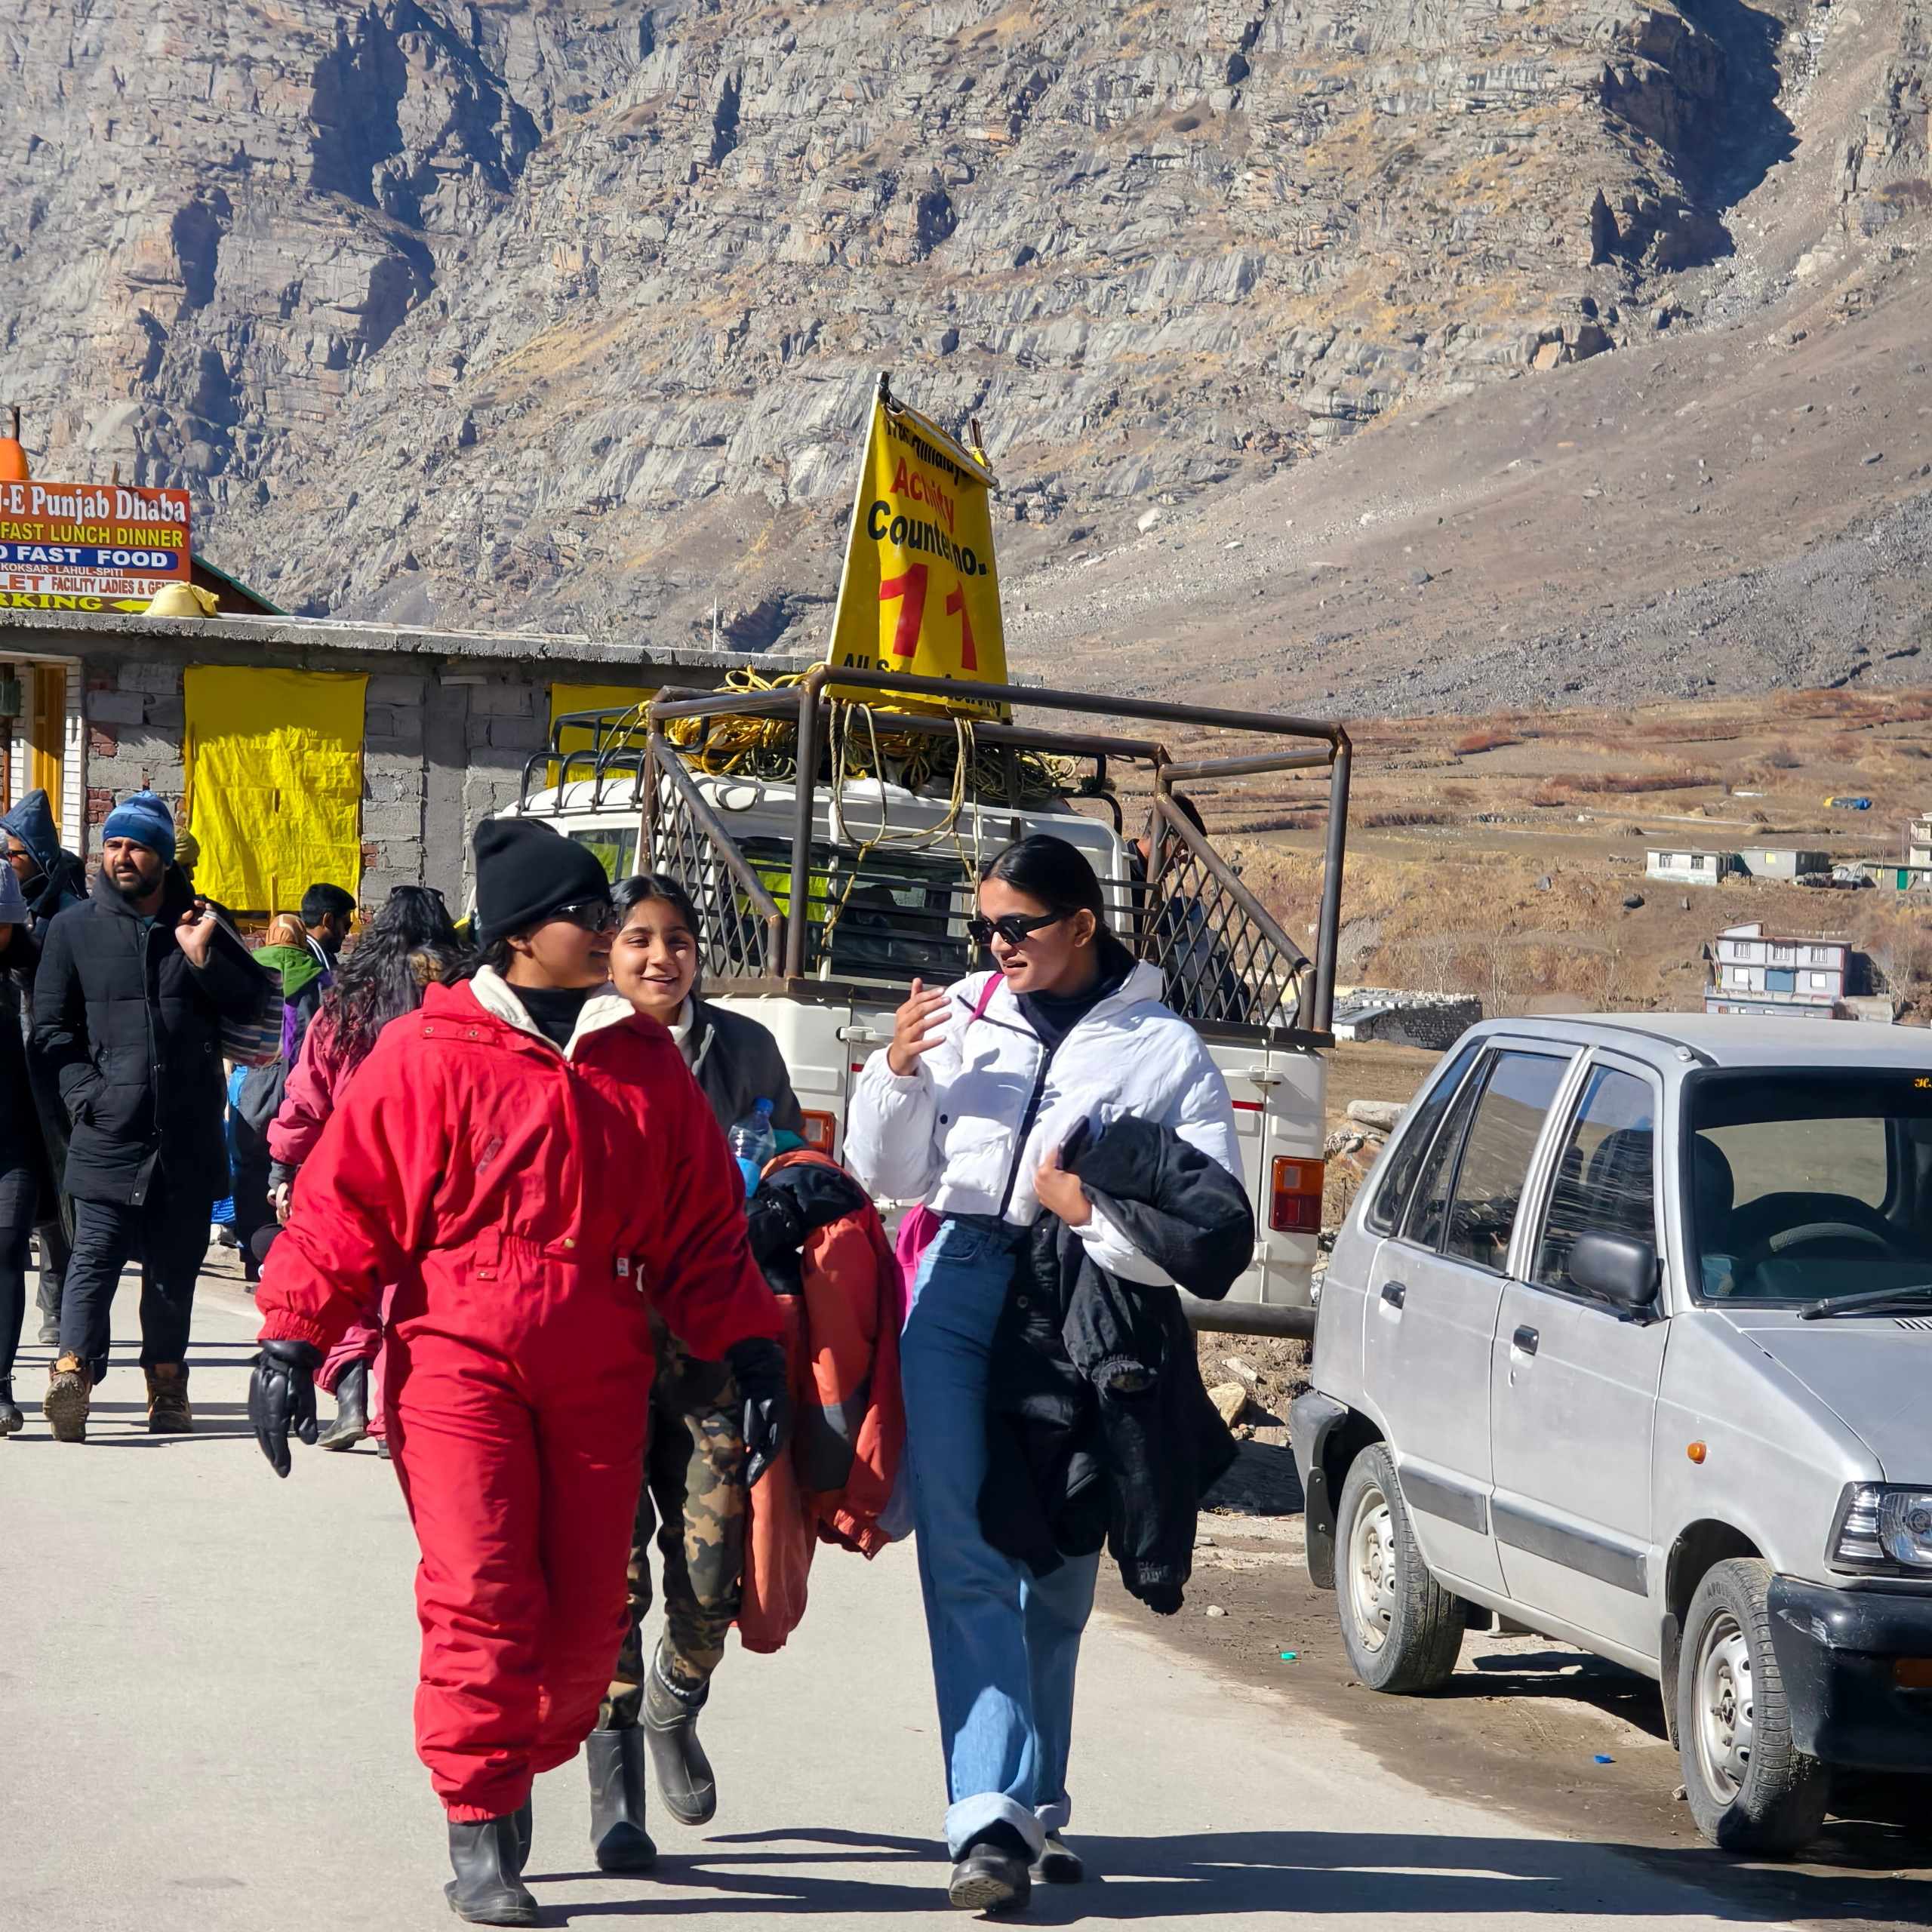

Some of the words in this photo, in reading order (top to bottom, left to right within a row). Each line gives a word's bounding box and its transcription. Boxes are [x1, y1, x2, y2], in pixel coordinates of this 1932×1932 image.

[0, 485, 26, 514] -E
[30, 486, 109, 525] Punjab
[115, 490, 186, 522] Dhaba
[50, 524, 110, 544] LUNCH
[117, 528, 183, 548] DINNER
[17, 546, 82, 563] FAST
[97, 549, 168, 568] FOOD
[51, 576, 96, 593] FACILITY
[99, 578, 134, 595] LADIES
[137, 580, 145, 595] &
